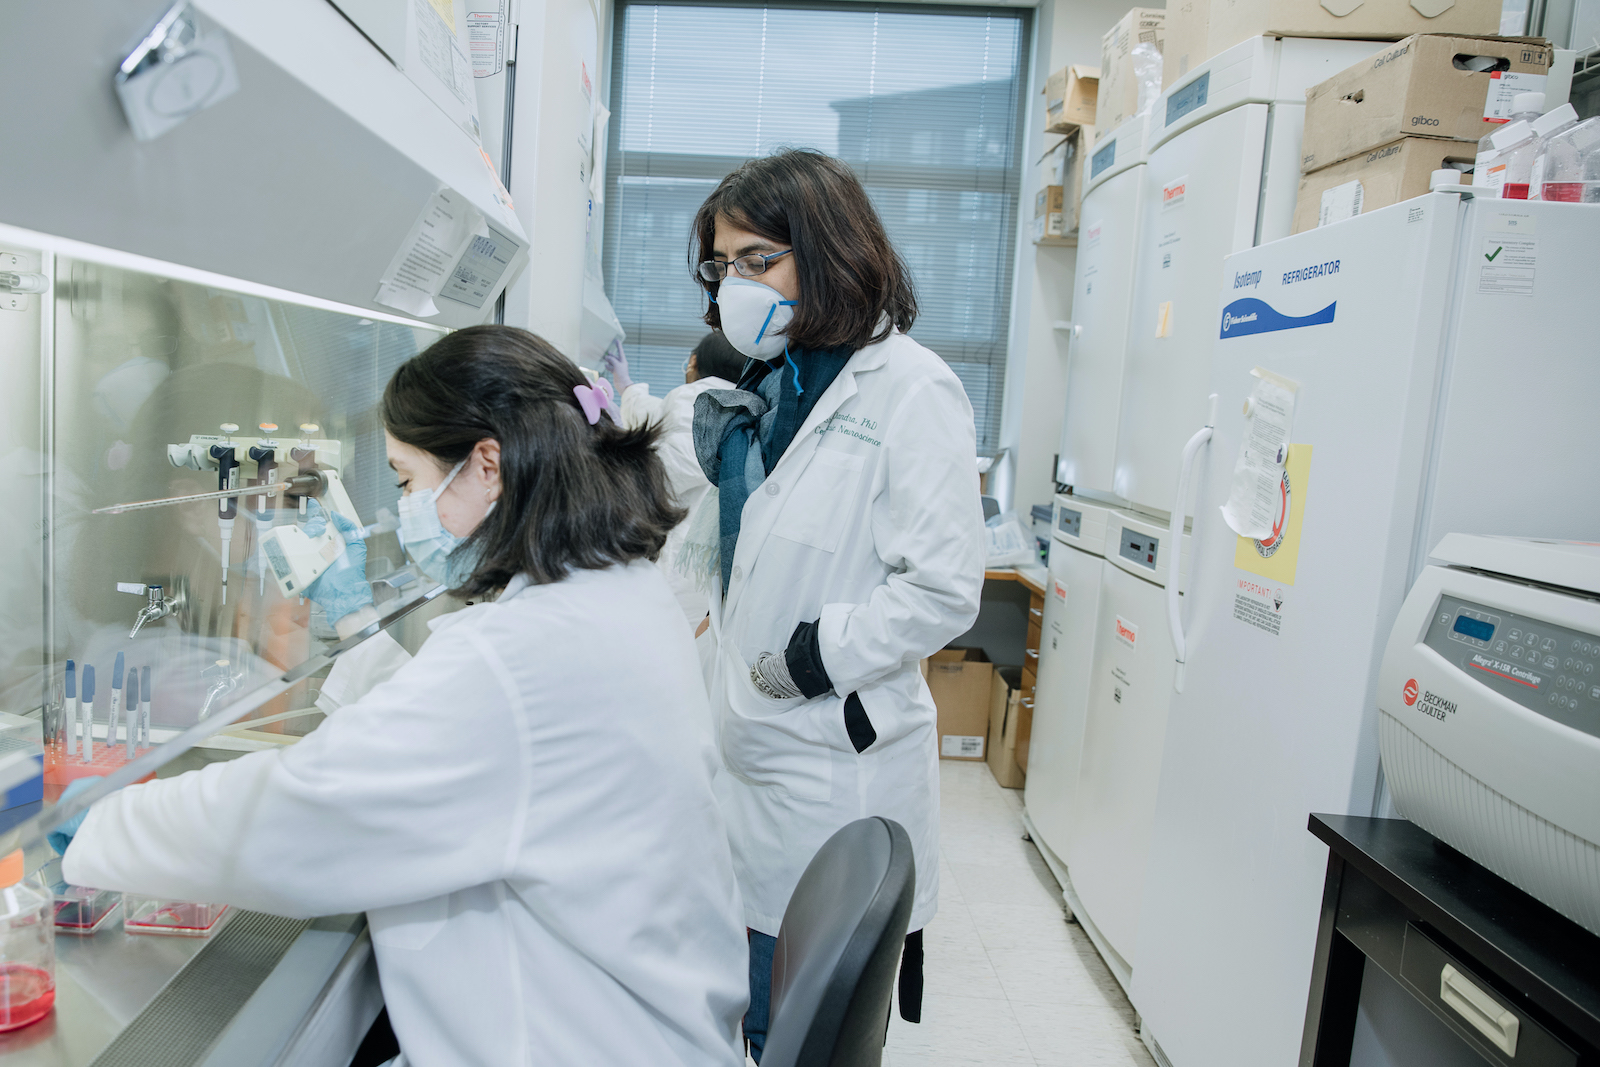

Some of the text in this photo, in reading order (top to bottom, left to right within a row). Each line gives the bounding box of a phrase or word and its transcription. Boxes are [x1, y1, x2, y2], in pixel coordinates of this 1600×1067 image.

[1374, 56, 1385, 69] Cell
[1411, 116, 1440, 126] gibco
[1366, 151, 1378, 163] Cell
[1163, 184, 1186, 202] Thermo
[1233, 259, 1341, 289] Isotemp REFRIGERATOR
[860, 417, 878, 431] PhD
[837, 424, 882, 447] Neuroscience
[1236, 578, 1272, 600] IMPORTANT!
[1116, 619, 1136, 643] Thermo
[1493, 660, 1512, 673] X-15R
[1511, 667, 1542, 684] Centrifuge
[1416, 701, 1447, 722] COULTER
[1423, 691, 1458, 715] BECKMAN
